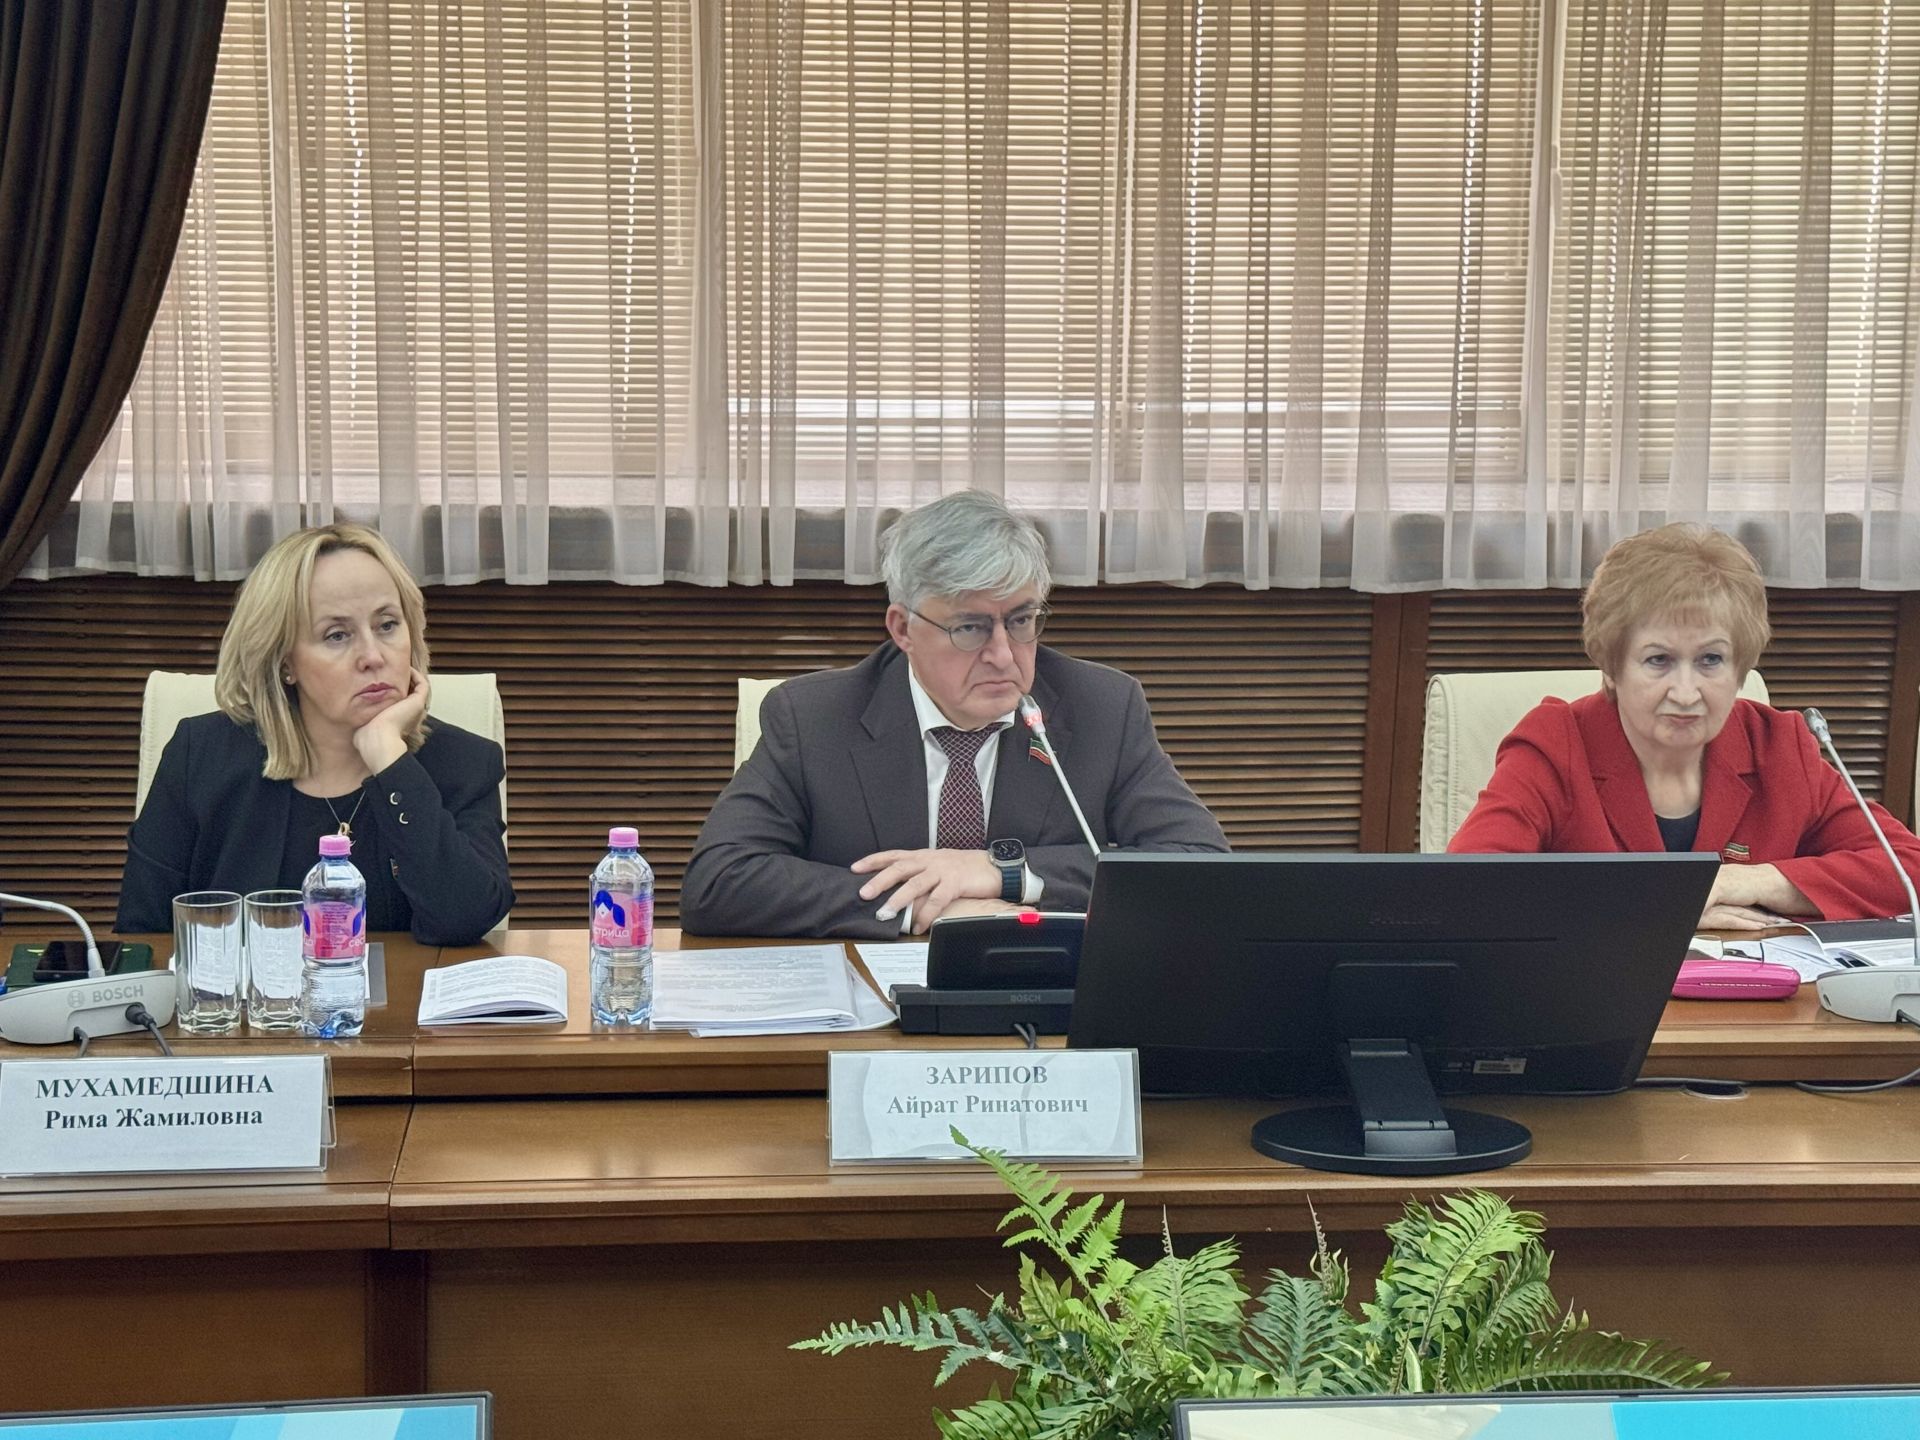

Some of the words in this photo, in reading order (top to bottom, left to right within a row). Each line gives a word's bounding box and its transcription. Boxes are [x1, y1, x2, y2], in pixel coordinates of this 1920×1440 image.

[92, 984, 144, 1003] BOSCH
[1010, 994, 1041, 1002] BOSCH
[926, 1065, 1048, 1085] ЗАРИПОВ
[35, 1074, 274, 1100] МУХАМЕДШИНА
[887, 1095, 959, 1118] Айрат
[966, 1095, 1089, 1114] Ринатович
[44, 1110, 108, 1130] Рима
[114, 1107, 263, 1128] Жамиловна
